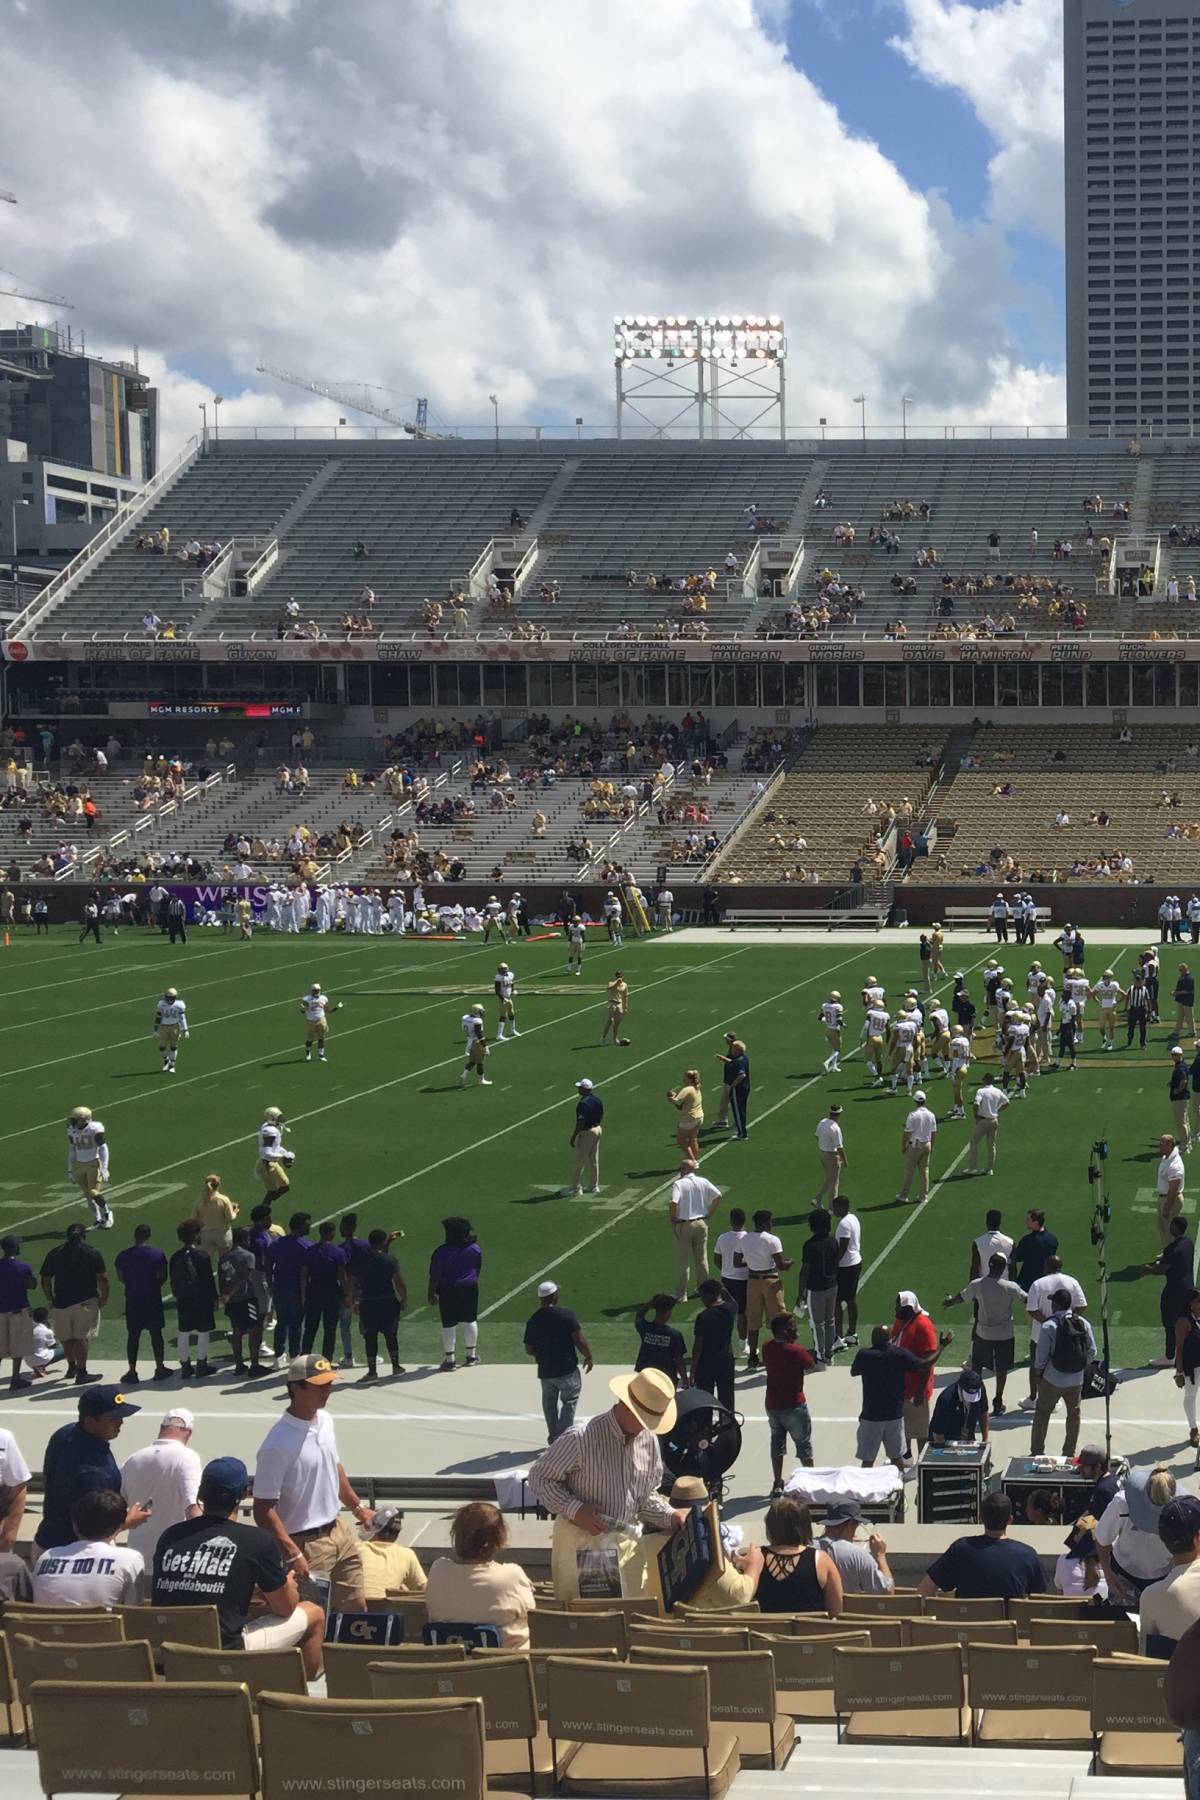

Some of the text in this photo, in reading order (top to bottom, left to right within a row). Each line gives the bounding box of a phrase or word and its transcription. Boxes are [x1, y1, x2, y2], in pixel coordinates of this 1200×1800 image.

[83, 641, 197, 649] PROFESSIONAL FOOTBALL
[582, 641, 670, 649] COLLEGE FOOTBALL
[86, 649, 200, 661] HALL OF FAME
[228, 650, 277, 660] GUYON
[378, 650, 422, 660] SHAW
[568, 650, 686, 661] HALL OF FAME
[712, 651, 781, 661] BAUGHAN
[809, 651, 864, 661] MORRIS
[903, 651, 944, 661] DAVIS
[960, 651, 1031, 661] HAMILTON
[1051, 651, 1092, 661] PUND
[1119, 651, 1185, 661] FLOWERS
[151, 706, 220, 714] MGM RESORTS
[271, 706, 294, 714] MGM
[37, 1557, 116, 1576] JUST DO IT.
[162, 1549, 235, 1577] Get Mad
[847, 1693, 953, 1705] www.stingerseats.com
[981, 1692, 1087, 1704] www.stingerseats.com
[562, 1719, 694, 1738] www.stingerseats.com
[61, 1767, 236, 1783] www.stingerseats.com
[281, 1776, 466, 1793] www.stingerseats.com
